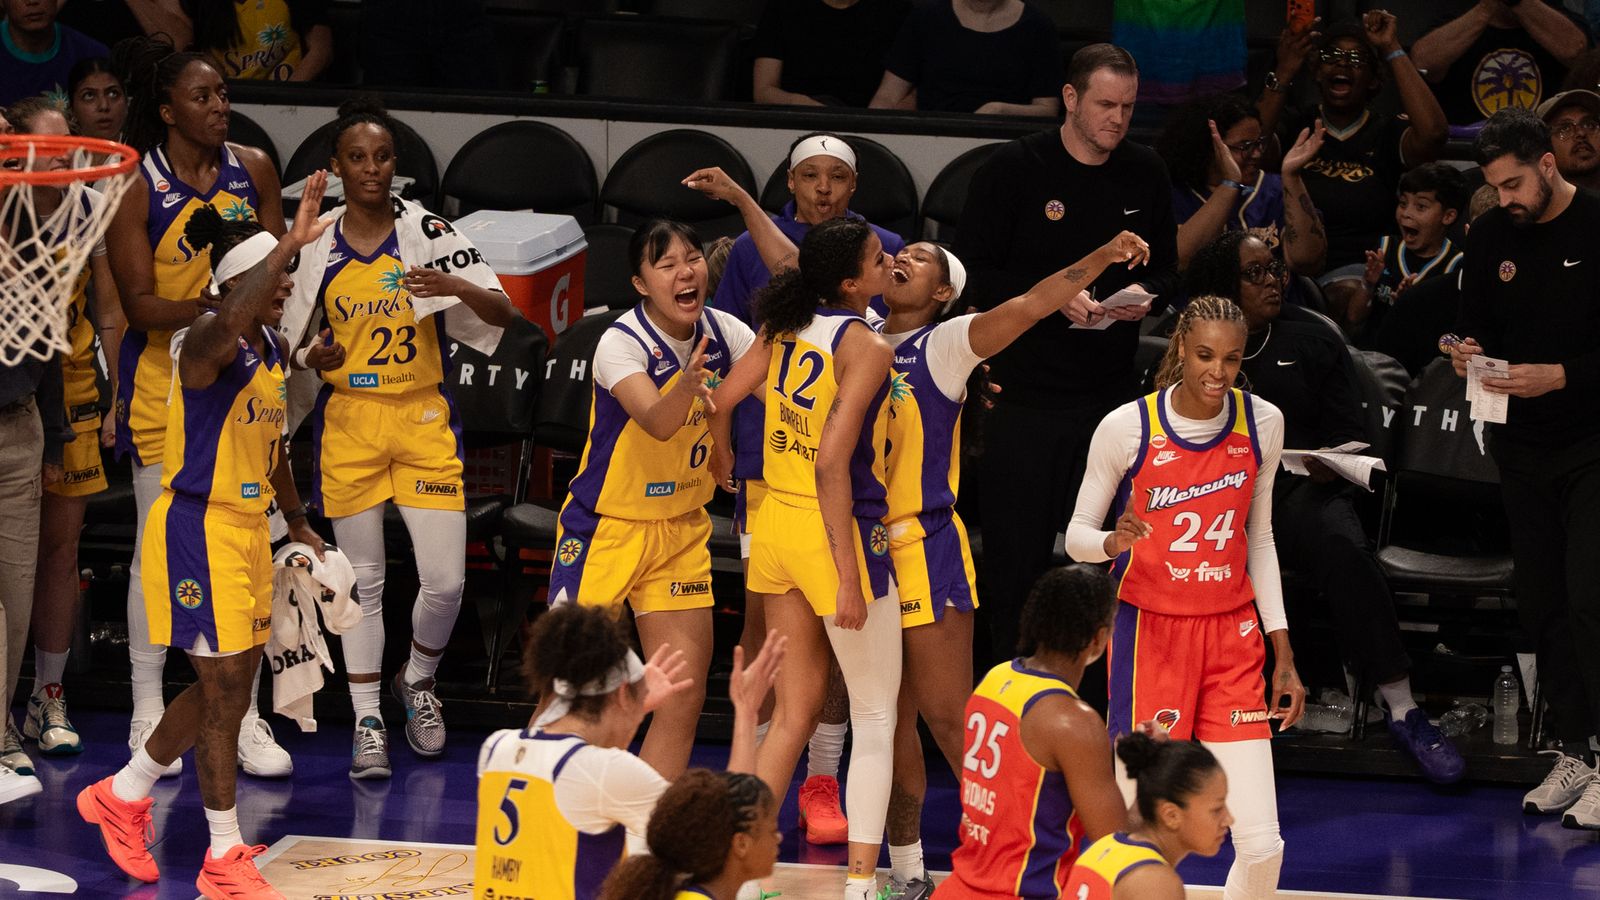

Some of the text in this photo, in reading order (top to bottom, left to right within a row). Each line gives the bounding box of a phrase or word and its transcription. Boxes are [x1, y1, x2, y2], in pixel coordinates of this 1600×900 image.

[164, 192, 181, 202] NIKE
[228, 180, 250, 190] Albert
[550, 272, 571, 335] G
[367, 325, 418, 366] 23
[352, 372, 416, 386] UCLA Health
[773, 340, 826, 411] 12
[779, 402, 812, 438] BURRELL
[265, 438, 279, 477] 1
[689, 429, 710, 470] 6
[788, 439, 818, 463] AT&T
[1157, 450, 1176, 459] NIKE
[73, 467, 100, 481] WNBA
[425, 483, 458, 495] WNBA
[649, 478, 702, 495] UCLA Health
[1146, 469, 1249, 513] Mercury
[1168, 508, 1237, 553] 24
[681, 582, 709, 594] WNBA
[900, 601, 921, 613] NBA
[963, 711, 1010, 780] 25
[493, 778, 529, 846] 5
